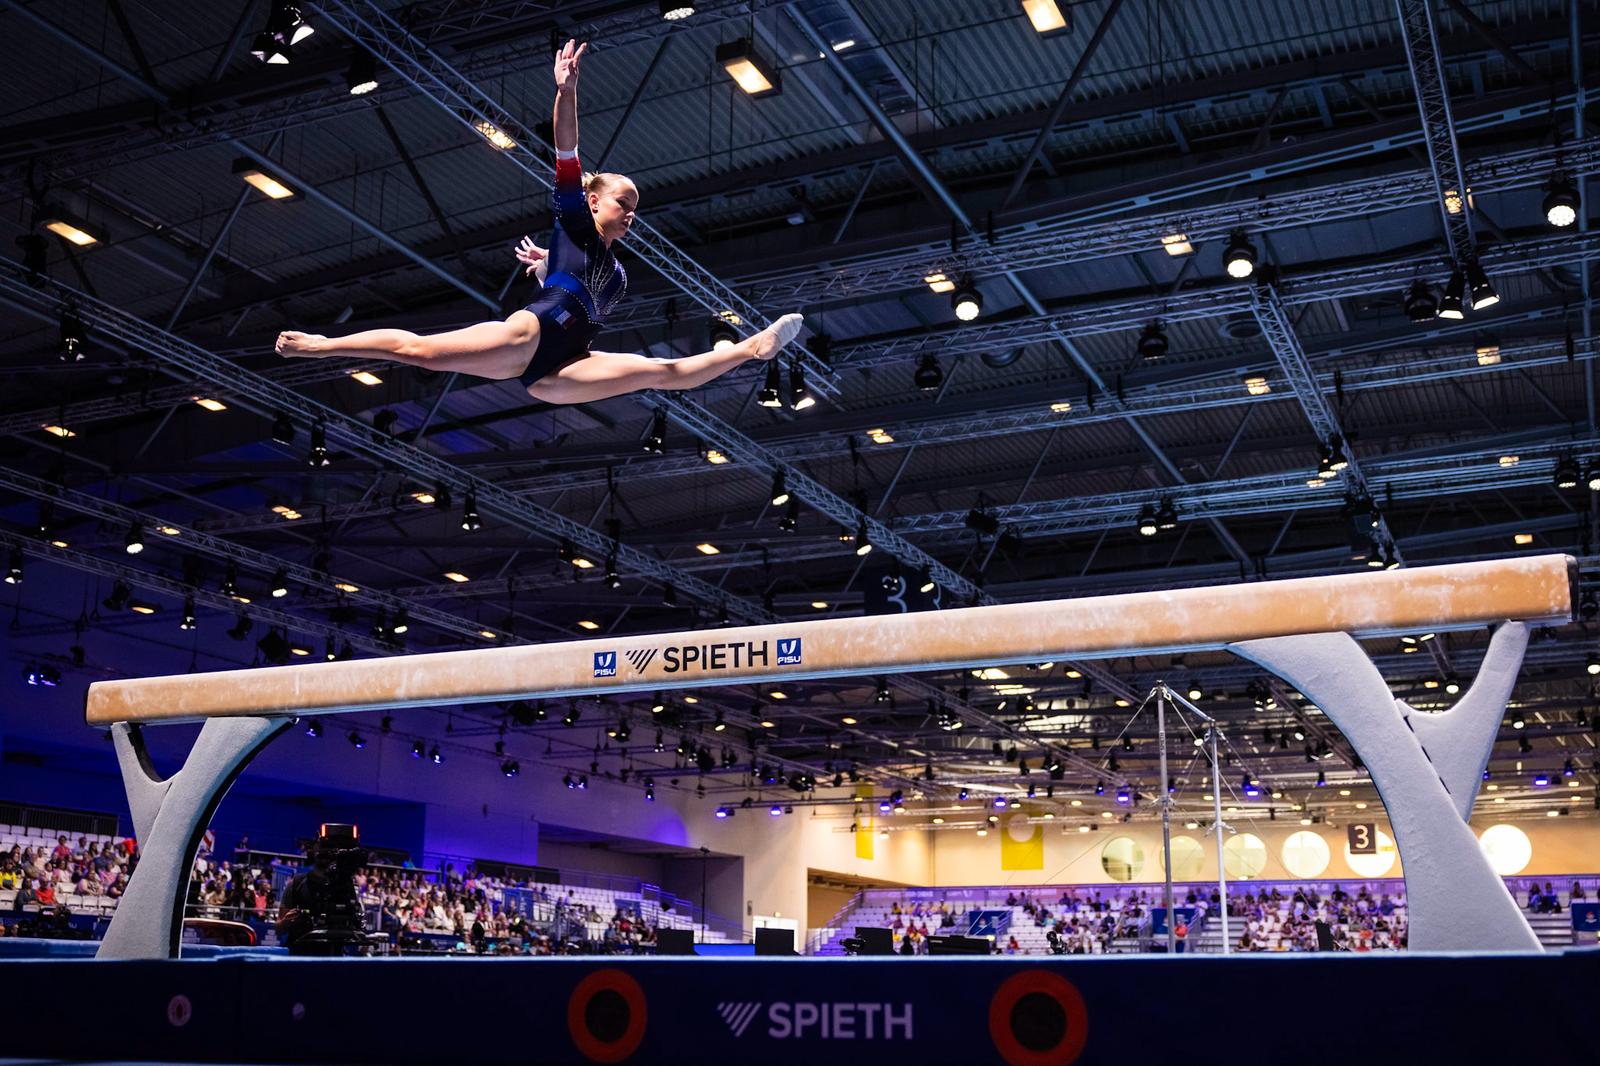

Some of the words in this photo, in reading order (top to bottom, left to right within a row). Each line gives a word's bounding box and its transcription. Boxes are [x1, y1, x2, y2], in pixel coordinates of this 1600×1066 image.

[663, 640, 768, 673] SPIETH
[777, 655, 801, 664] FISU
[594, 668, 616, 676] FISU
[1354, 825, 1369, 849] 3
[768, 1002, 913, 1039] SPIETH
